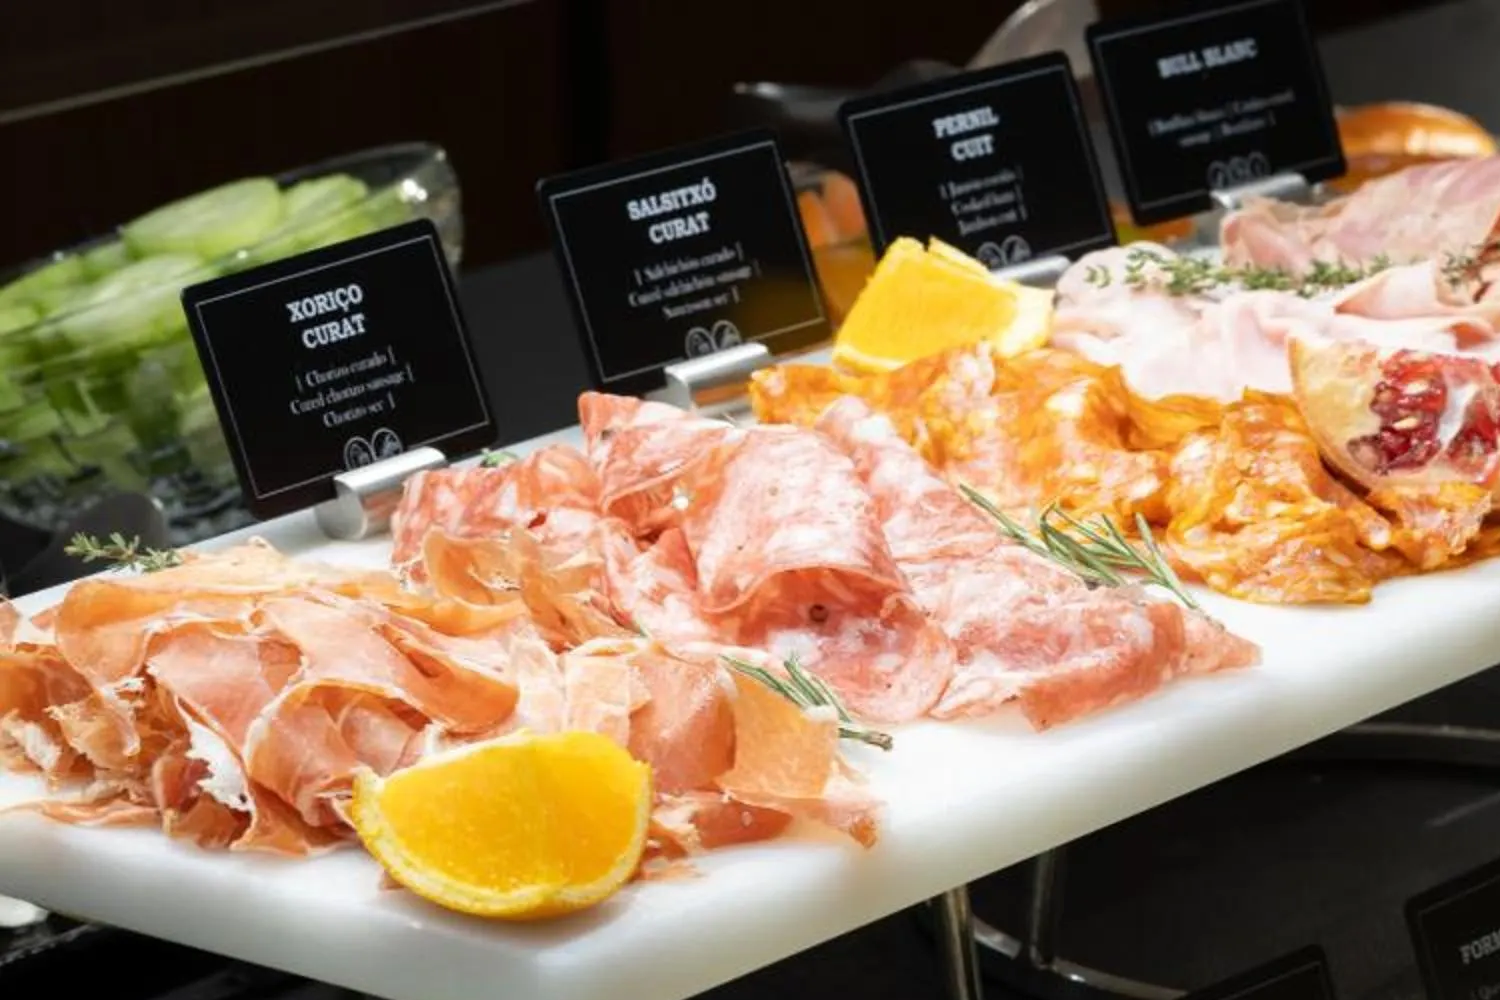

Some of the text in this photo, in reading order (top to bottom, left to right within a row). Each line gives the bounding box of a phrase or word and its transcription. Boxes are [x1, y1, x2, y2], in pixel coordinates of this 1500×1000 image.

[1203, 37, 1258, 68] BLANC
[932, 106, 999, 139] PERNIL
[951, 134, 994, 161] CUIT
[627, 176, 716, 221] SALSITXÓ
[648, 211, 710, 244] CURAT
[285, 283, 363, 323] XORIÇO
[302, 312, 366, 348] CURAT
